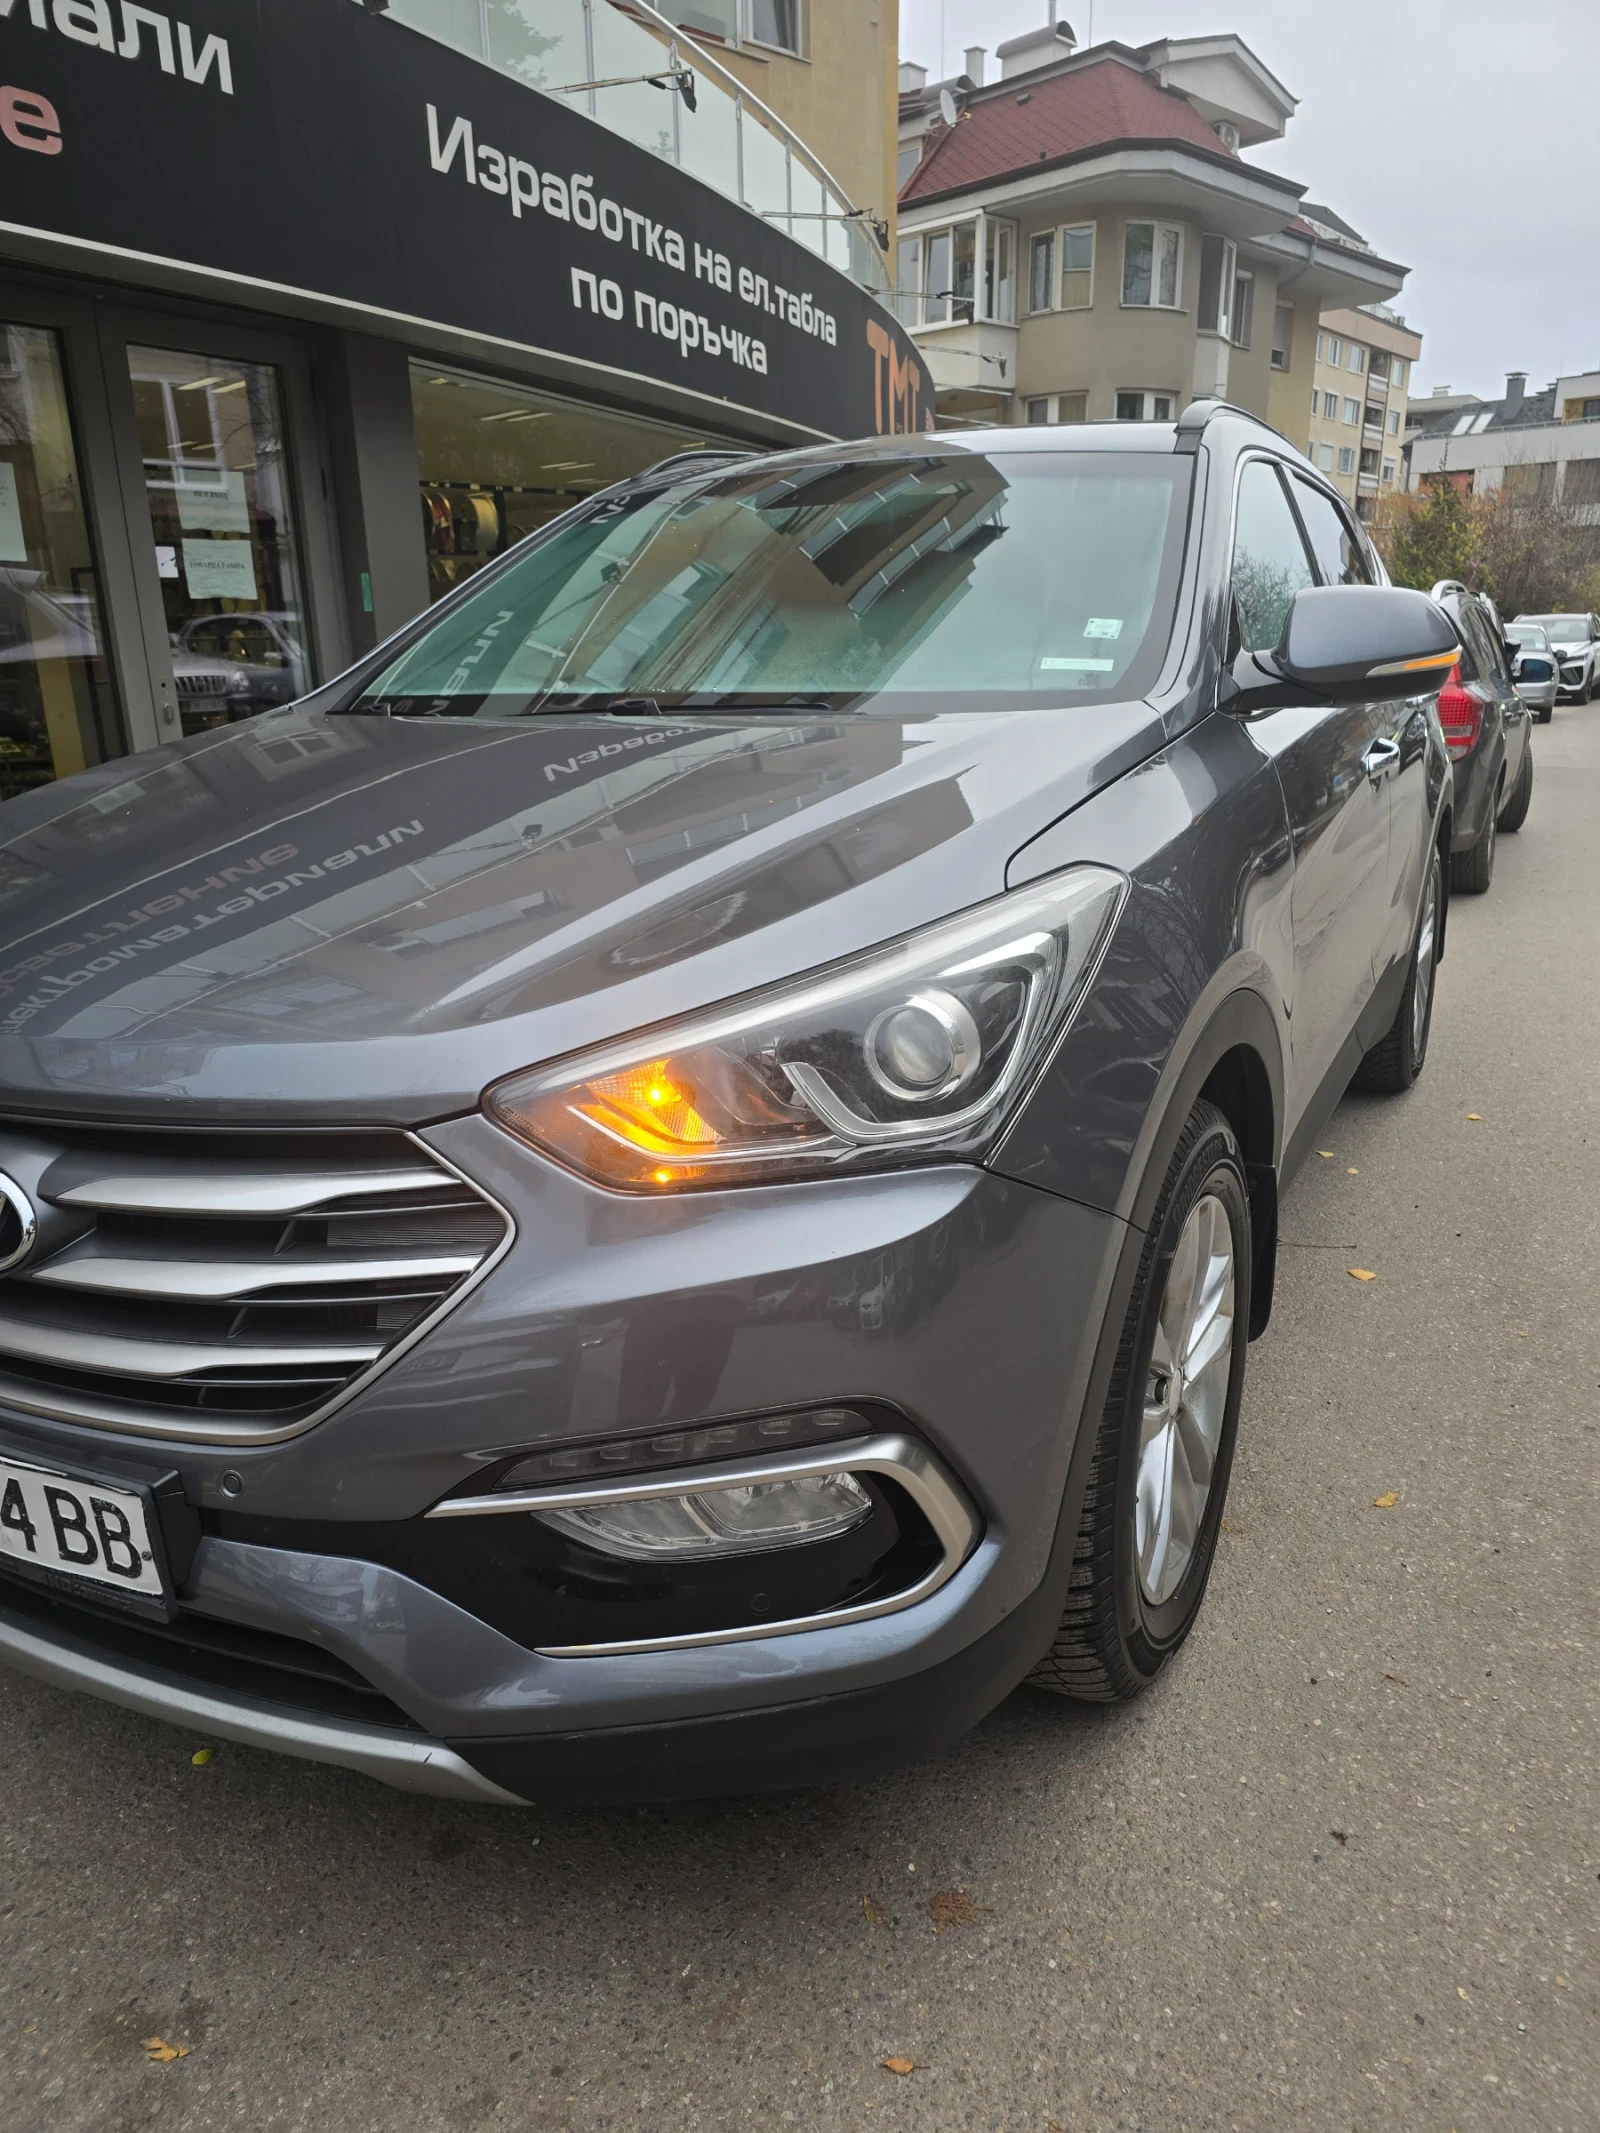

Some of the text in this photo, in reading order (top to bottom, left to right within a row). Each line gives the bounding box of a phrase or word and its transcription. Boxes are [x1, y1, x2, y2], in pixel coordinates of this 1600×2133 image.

[426, 103, 838, 347] Изработка на ел.табла
[570, 266, 768, 375] по поръчка
